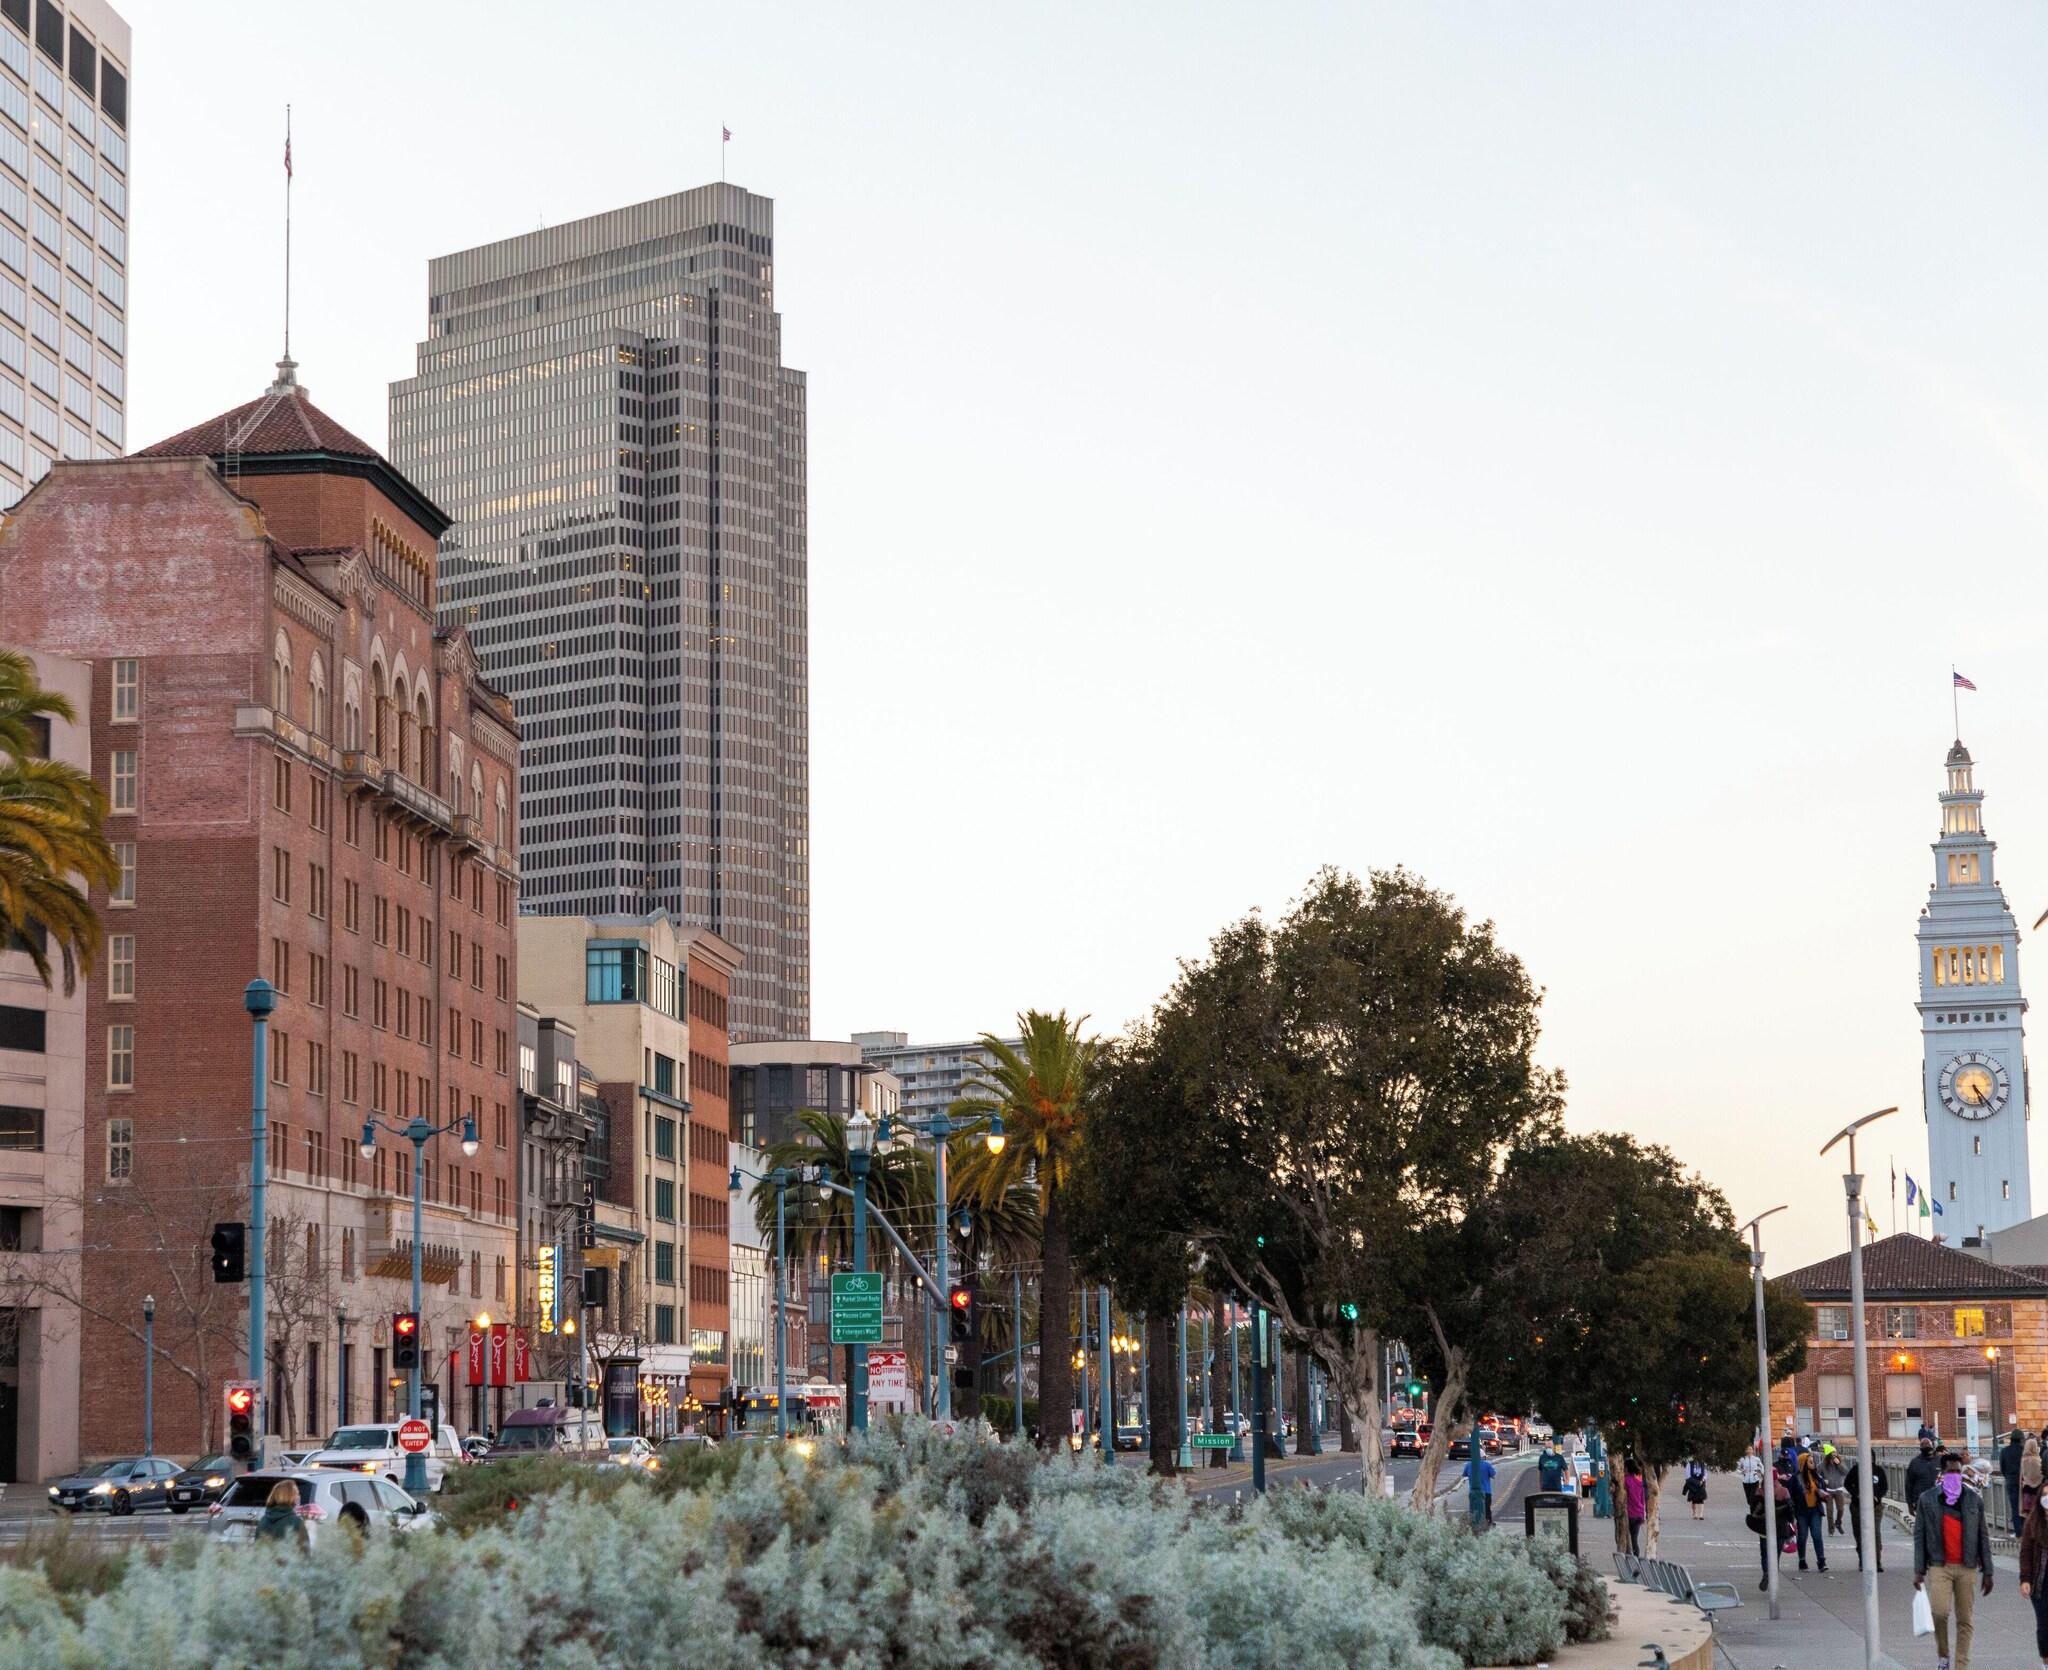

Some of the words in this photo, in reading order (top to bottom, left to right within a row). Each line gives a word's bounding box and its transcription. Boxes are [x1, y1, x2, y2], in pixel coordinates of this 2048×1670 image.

[583, 1183, 593, 1247] HOTEL
[870, 1366, 881, 1374] NO
[872, 1379, 885, 1388] ANY
[888, 1379, 903, 1388] TIME
[1197, 1437, 1230, 1445] Mission
